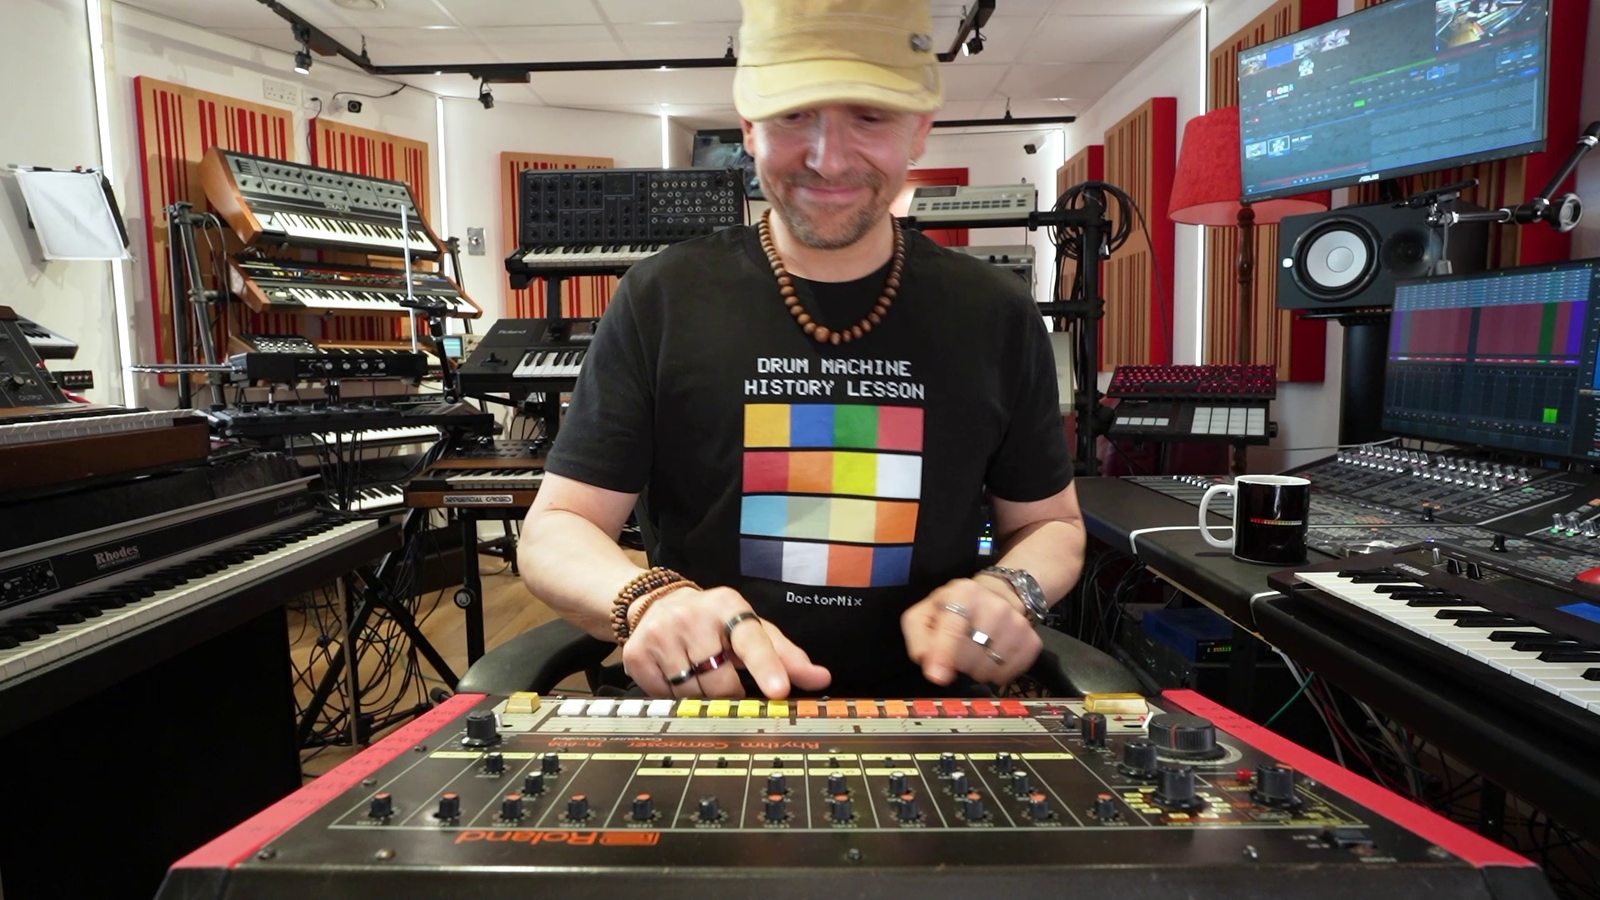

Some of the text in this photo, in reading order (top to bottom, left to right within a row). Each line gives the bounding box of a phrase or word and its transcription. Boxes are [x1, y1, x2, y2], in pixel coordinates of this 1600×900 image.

[757, 357, 912, 377] DRUM MACHINE
[744, 379, 925, 401] HISTORY LESSON
[93, 545, 139, 565] Rhodes
[786, 591, 863, 607] DoctorMix
[547, 740, 820, 750] Rhythm Composer TR-808
[454, 830, 599, 845] Roland
